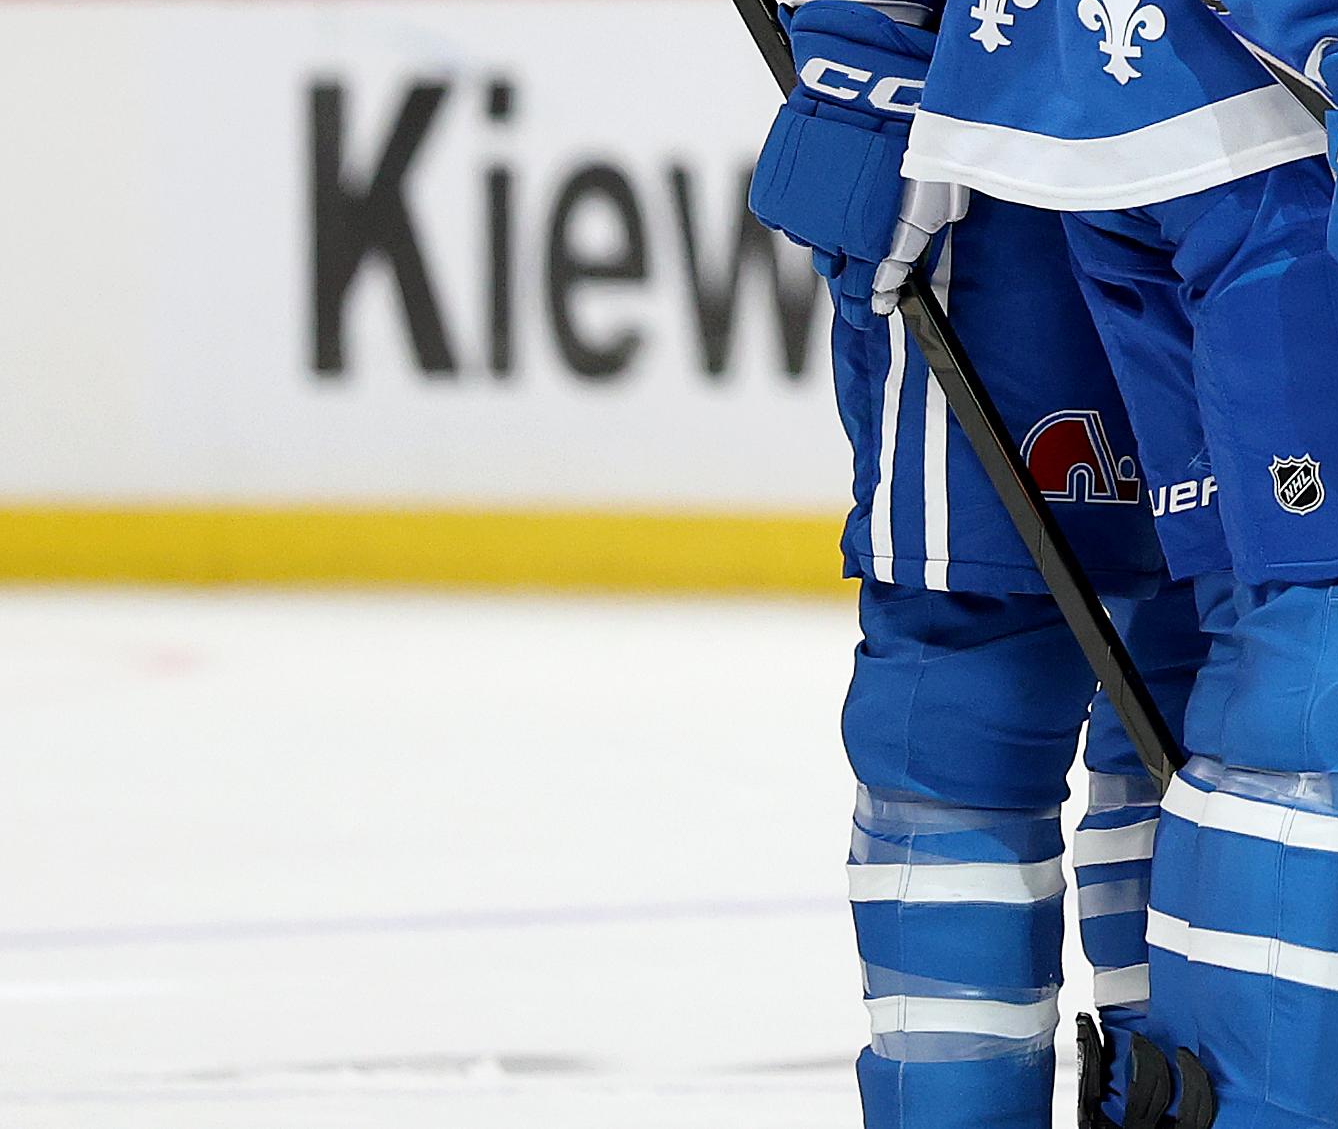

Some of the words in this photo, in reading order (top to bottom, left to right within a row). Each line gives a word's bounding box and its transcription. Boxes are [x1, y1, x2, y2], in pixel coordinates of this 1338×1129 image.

[800, 57, 926, 114] CC
[308, 77, 830, 384] Kiew
[1284, 470, 1311, 503] NHL
